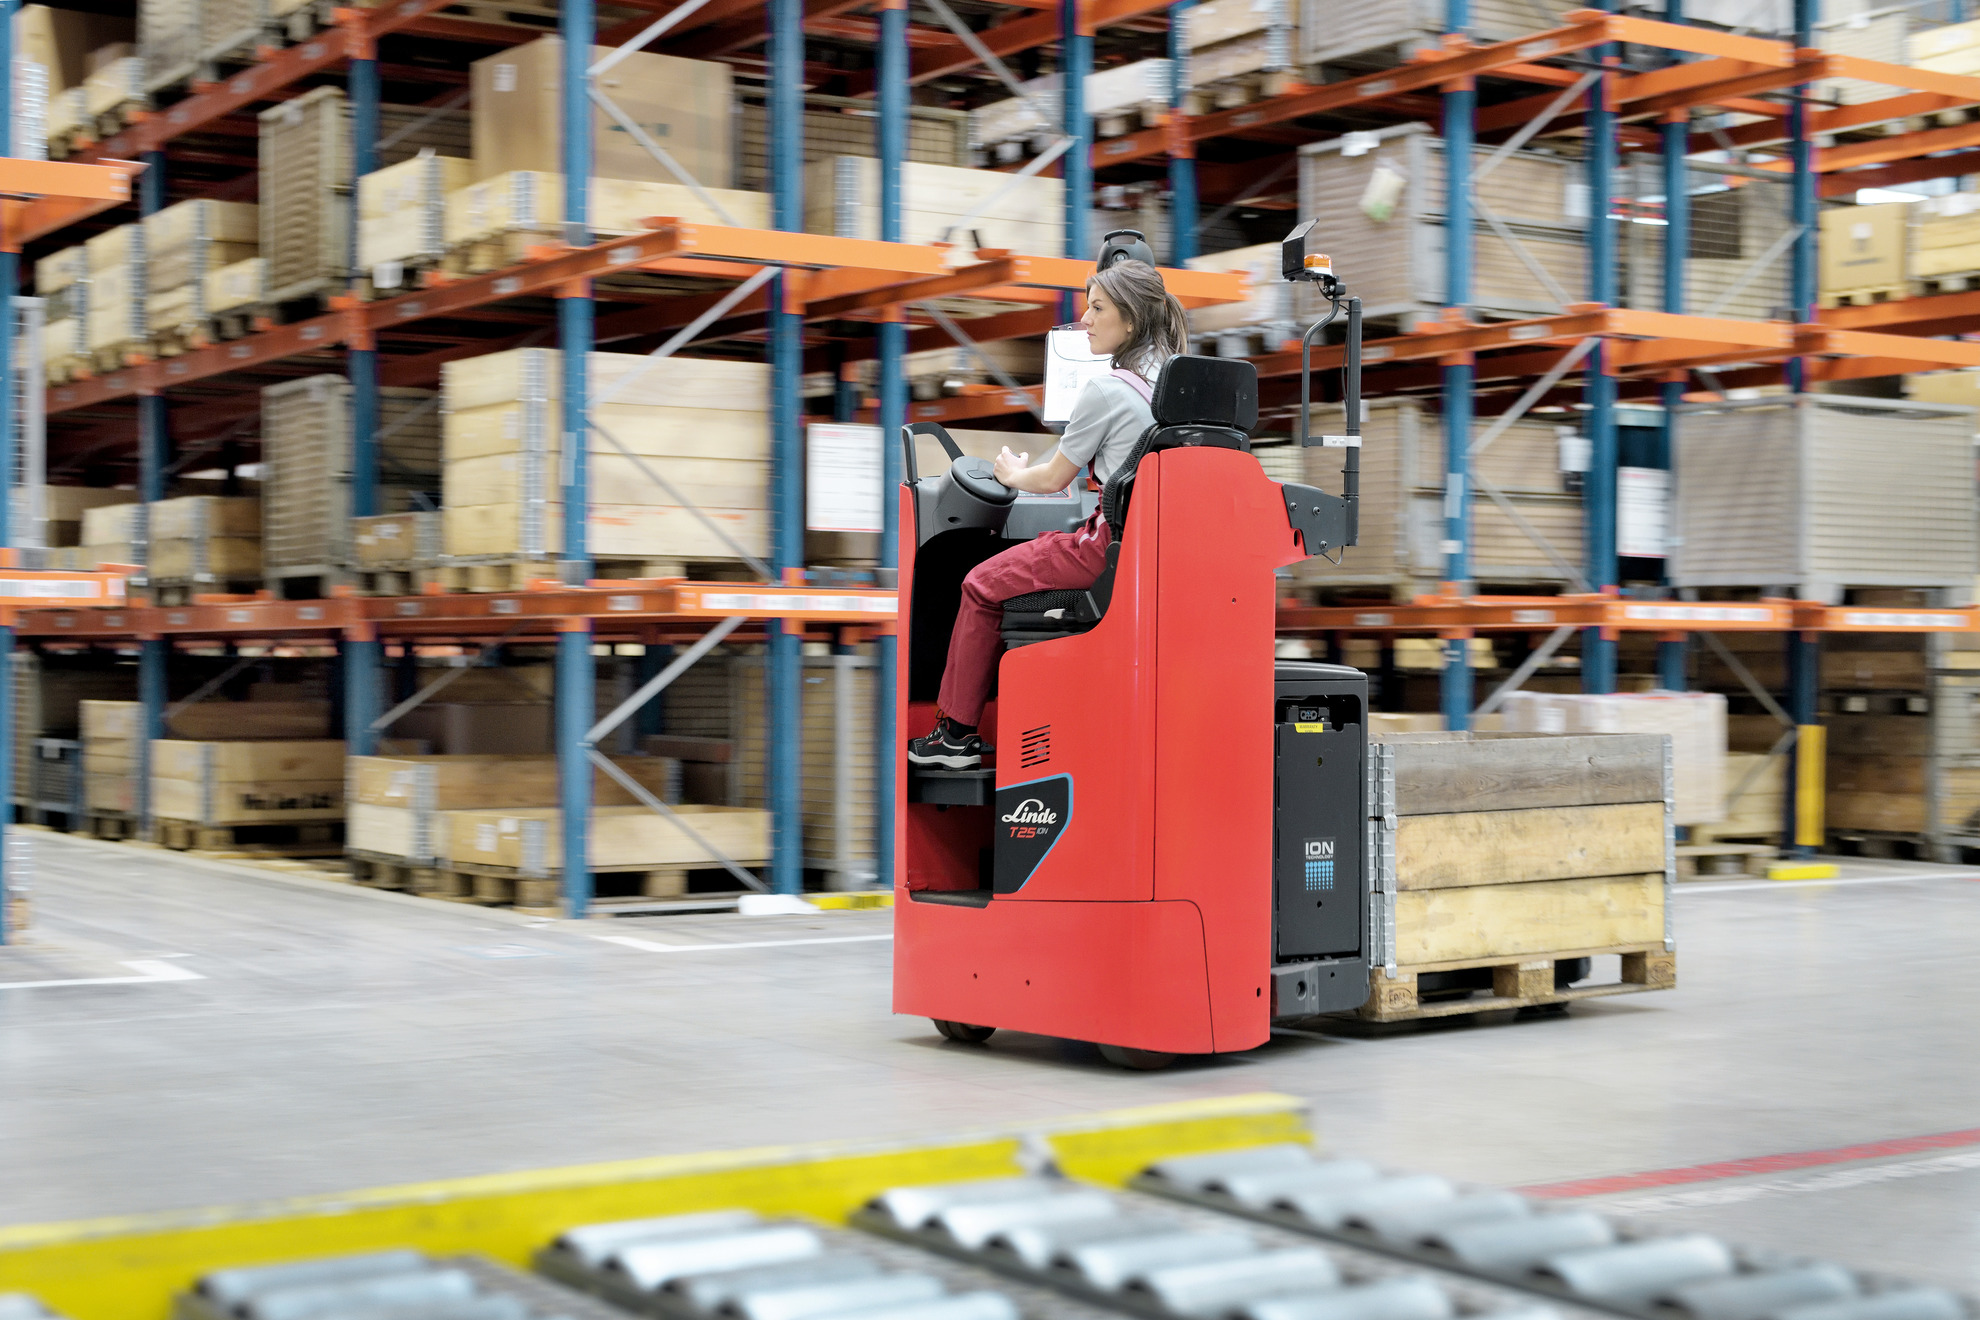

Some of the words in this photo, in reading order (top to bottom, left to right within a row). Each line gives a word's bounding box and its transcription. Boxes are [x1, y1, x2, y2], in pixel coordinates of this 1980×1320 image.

[1001, 798, 1057, 825] Linde
[1010, 826, 1037, 838] T25
[1305, 841, 1334, 855] ION
